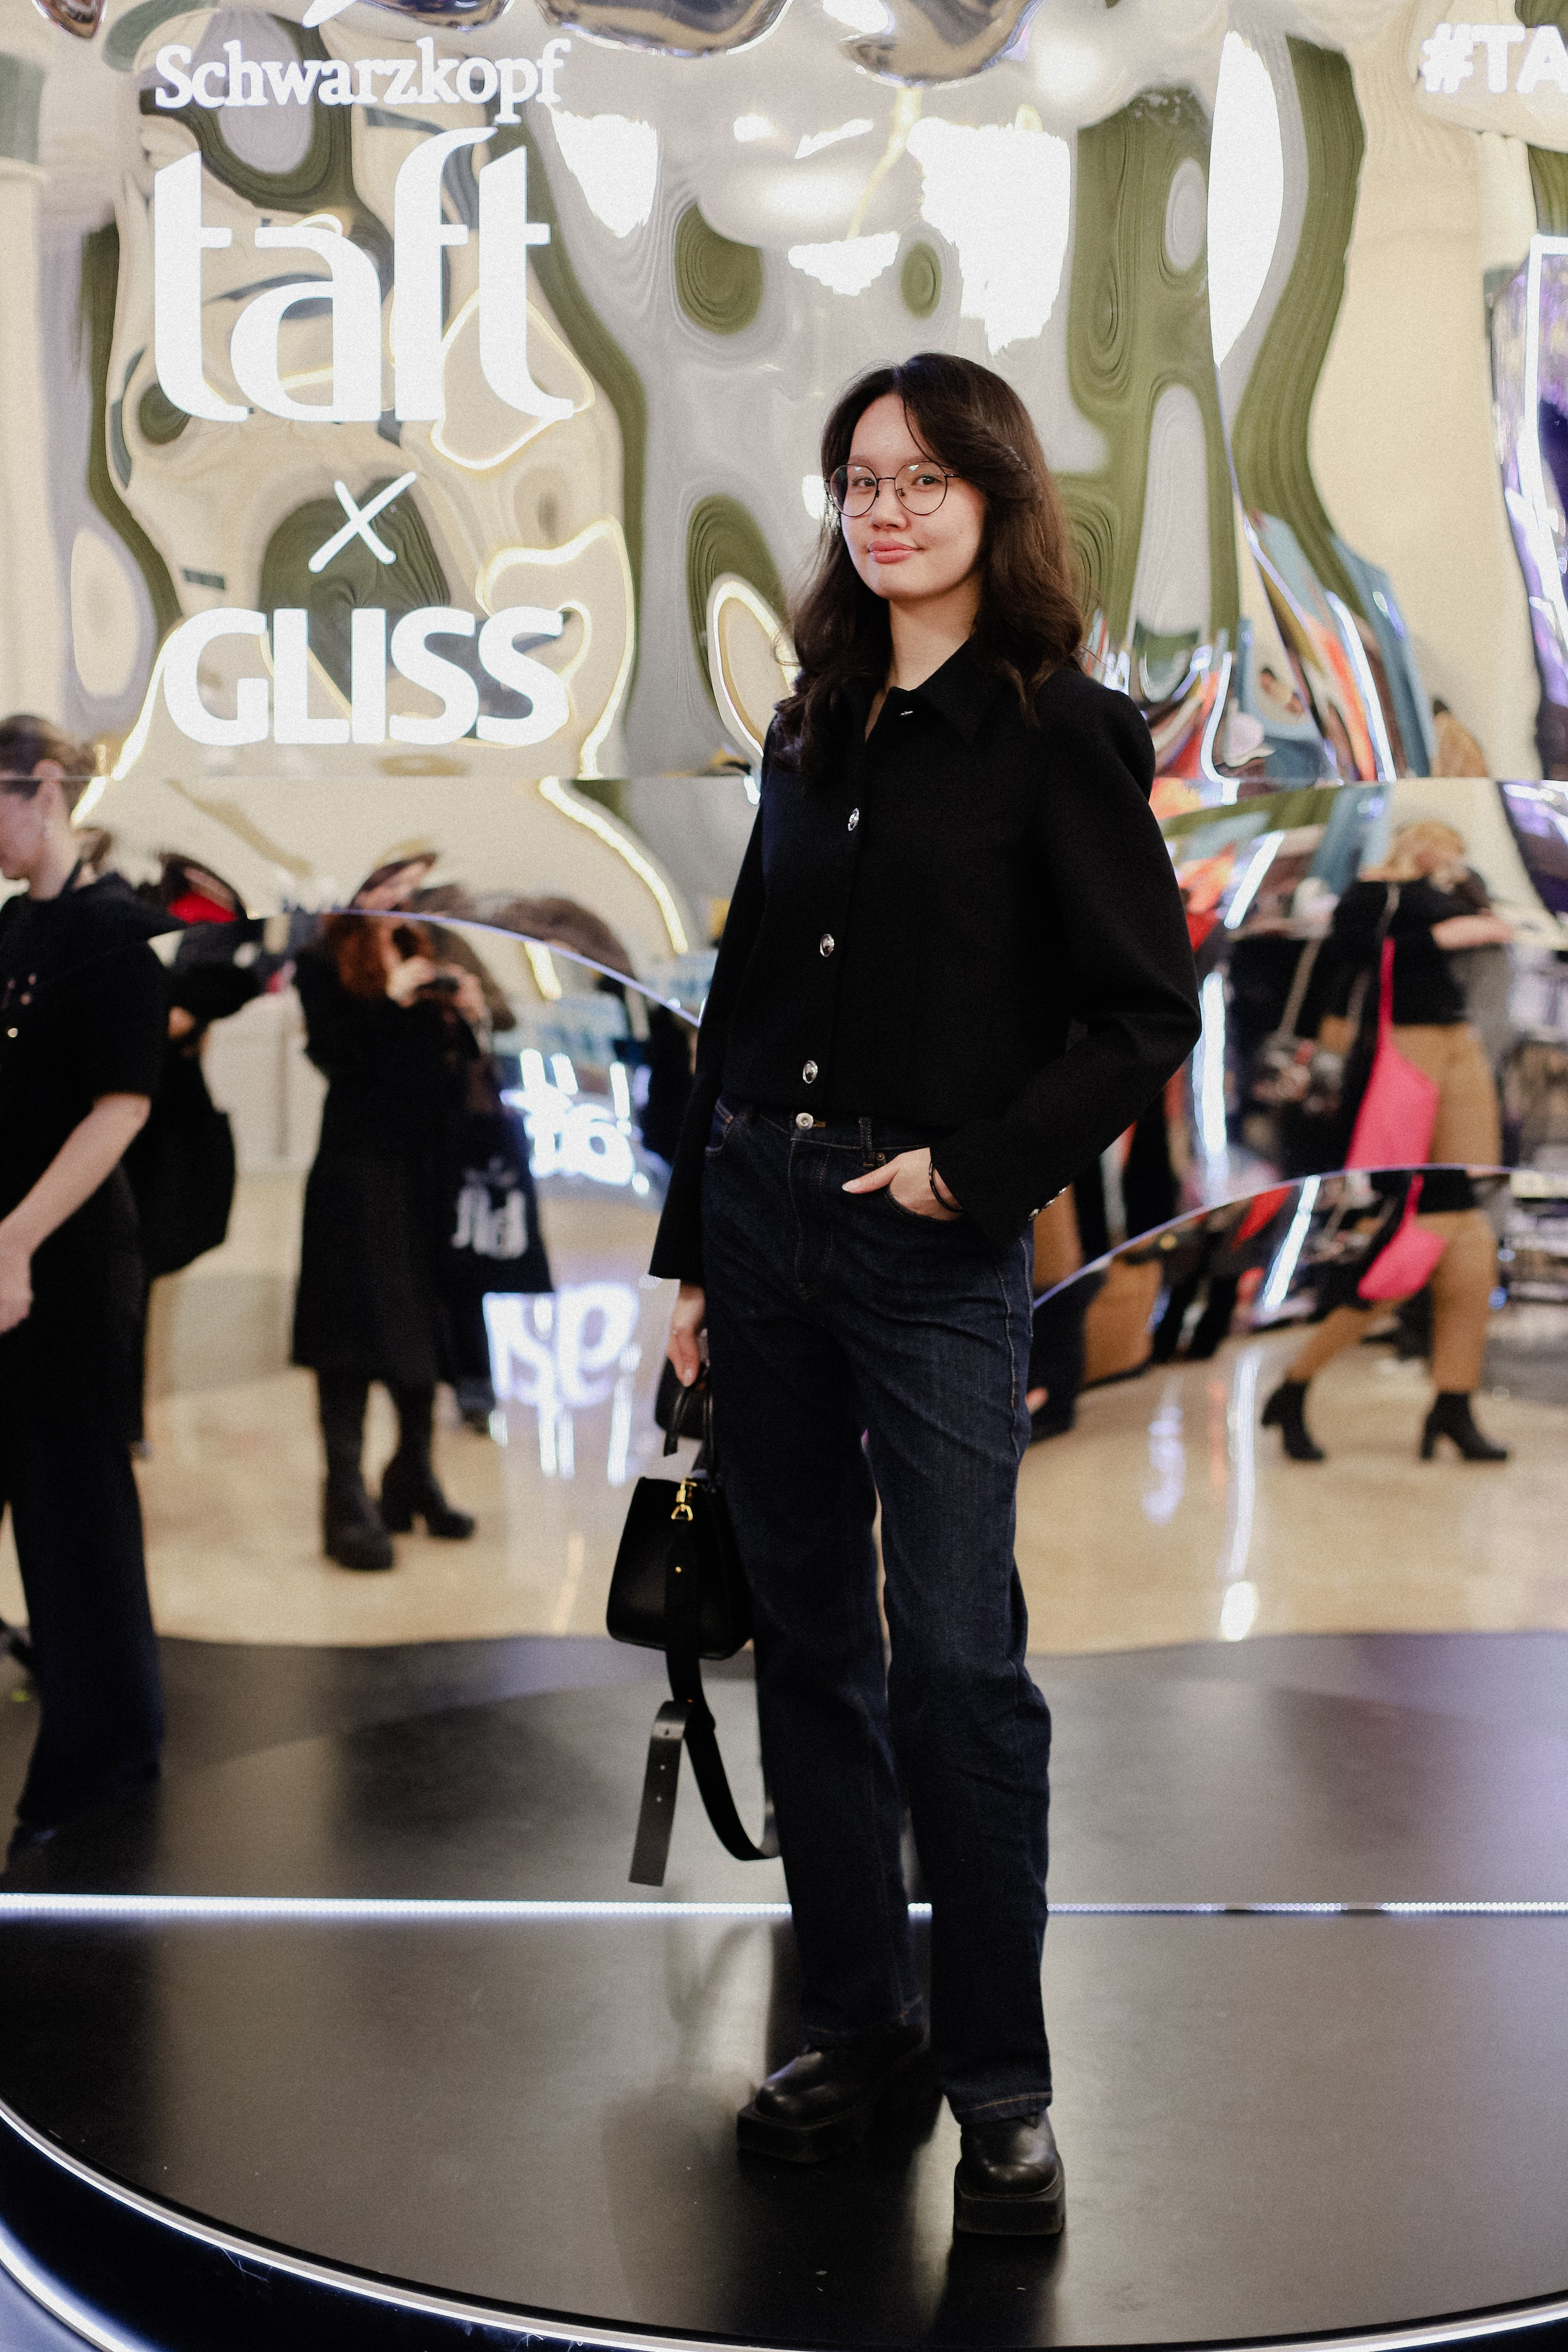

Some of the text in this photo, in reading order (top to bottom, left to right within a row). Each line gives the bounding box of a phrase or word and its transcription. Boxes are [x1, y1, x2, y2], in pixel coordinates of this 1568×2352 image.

[154, 37, 571, 124] Schwarzkopf
[1421, 23, 1568, 94] #TA
[154, 126, 575, 423] taft
[163, 606, 570, 747] GLISS
